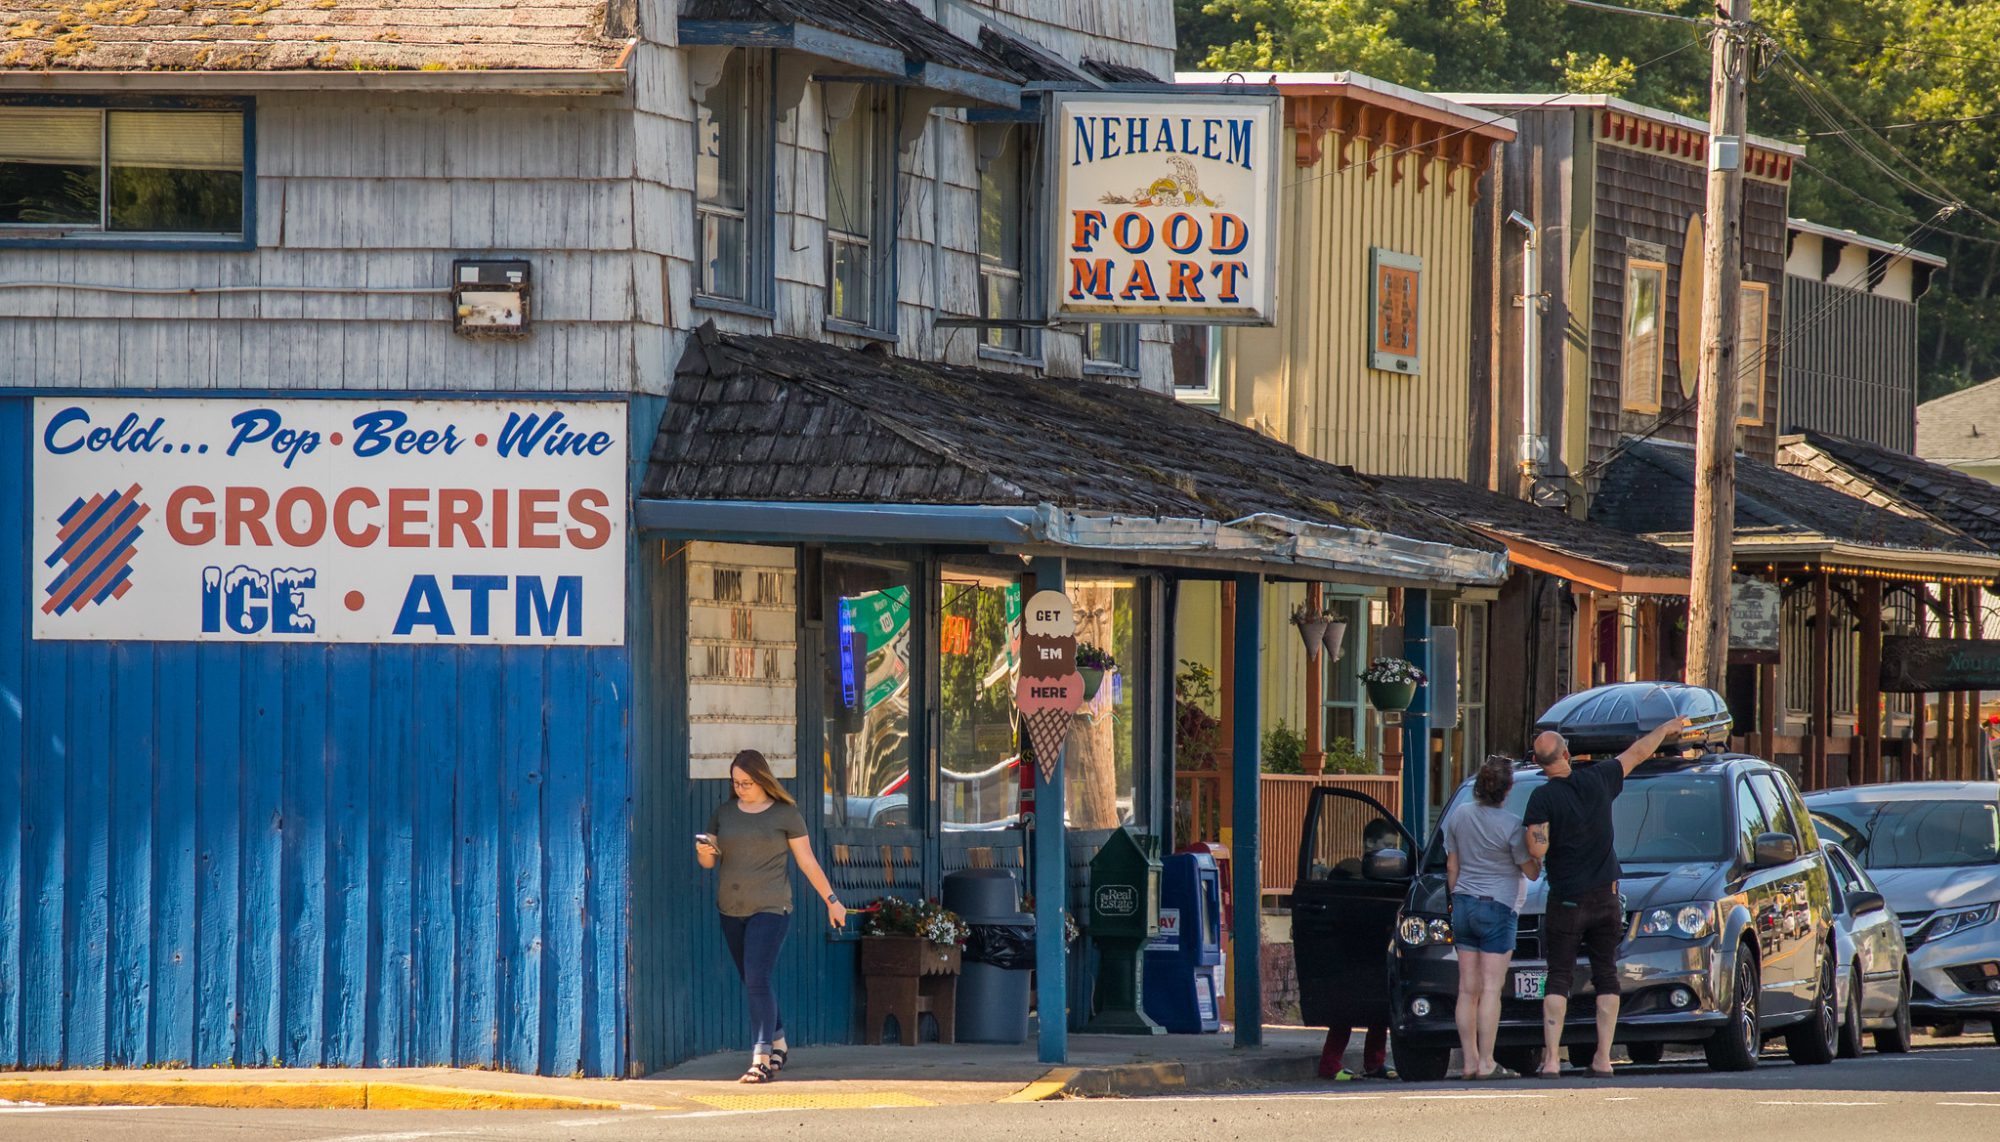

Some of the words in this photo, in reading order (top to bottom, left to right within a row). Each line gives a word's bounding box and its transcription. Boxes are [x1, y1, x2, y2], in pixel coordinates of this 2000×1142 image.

[1073, 116, 1253, 169] NEHALEM
[1071, 210, 1249, 255] FOOD
[1069, 257, 1249, 303] MART
[44, 407, 209, 455] Cold...
[228, 409, 322, 469] Pop
[352, 410, 464, 458] Beer
[497, 411, 615, 458] Wine
[166, 486, 611, 549] GROCERIES
[201, 565, 316, 634] ICE
[393, 574, 583, 637] ATM
[713, 568, 742, 601] HOURS
[757, 572, 783, 605] DAILY
[941, 614, 970, 655] OPEN
[1036, 610, 1061, 622] GET
[707, 645, 731, 677] MILK
[1037, 644, 1062, 660] 'EM
[1031, 686, 1068, 699] HERE
[1100, 898, 1133, 909] Estate
[1108, 888, 1132, 900] Real
[1517, 977, 1539, 993] 135
